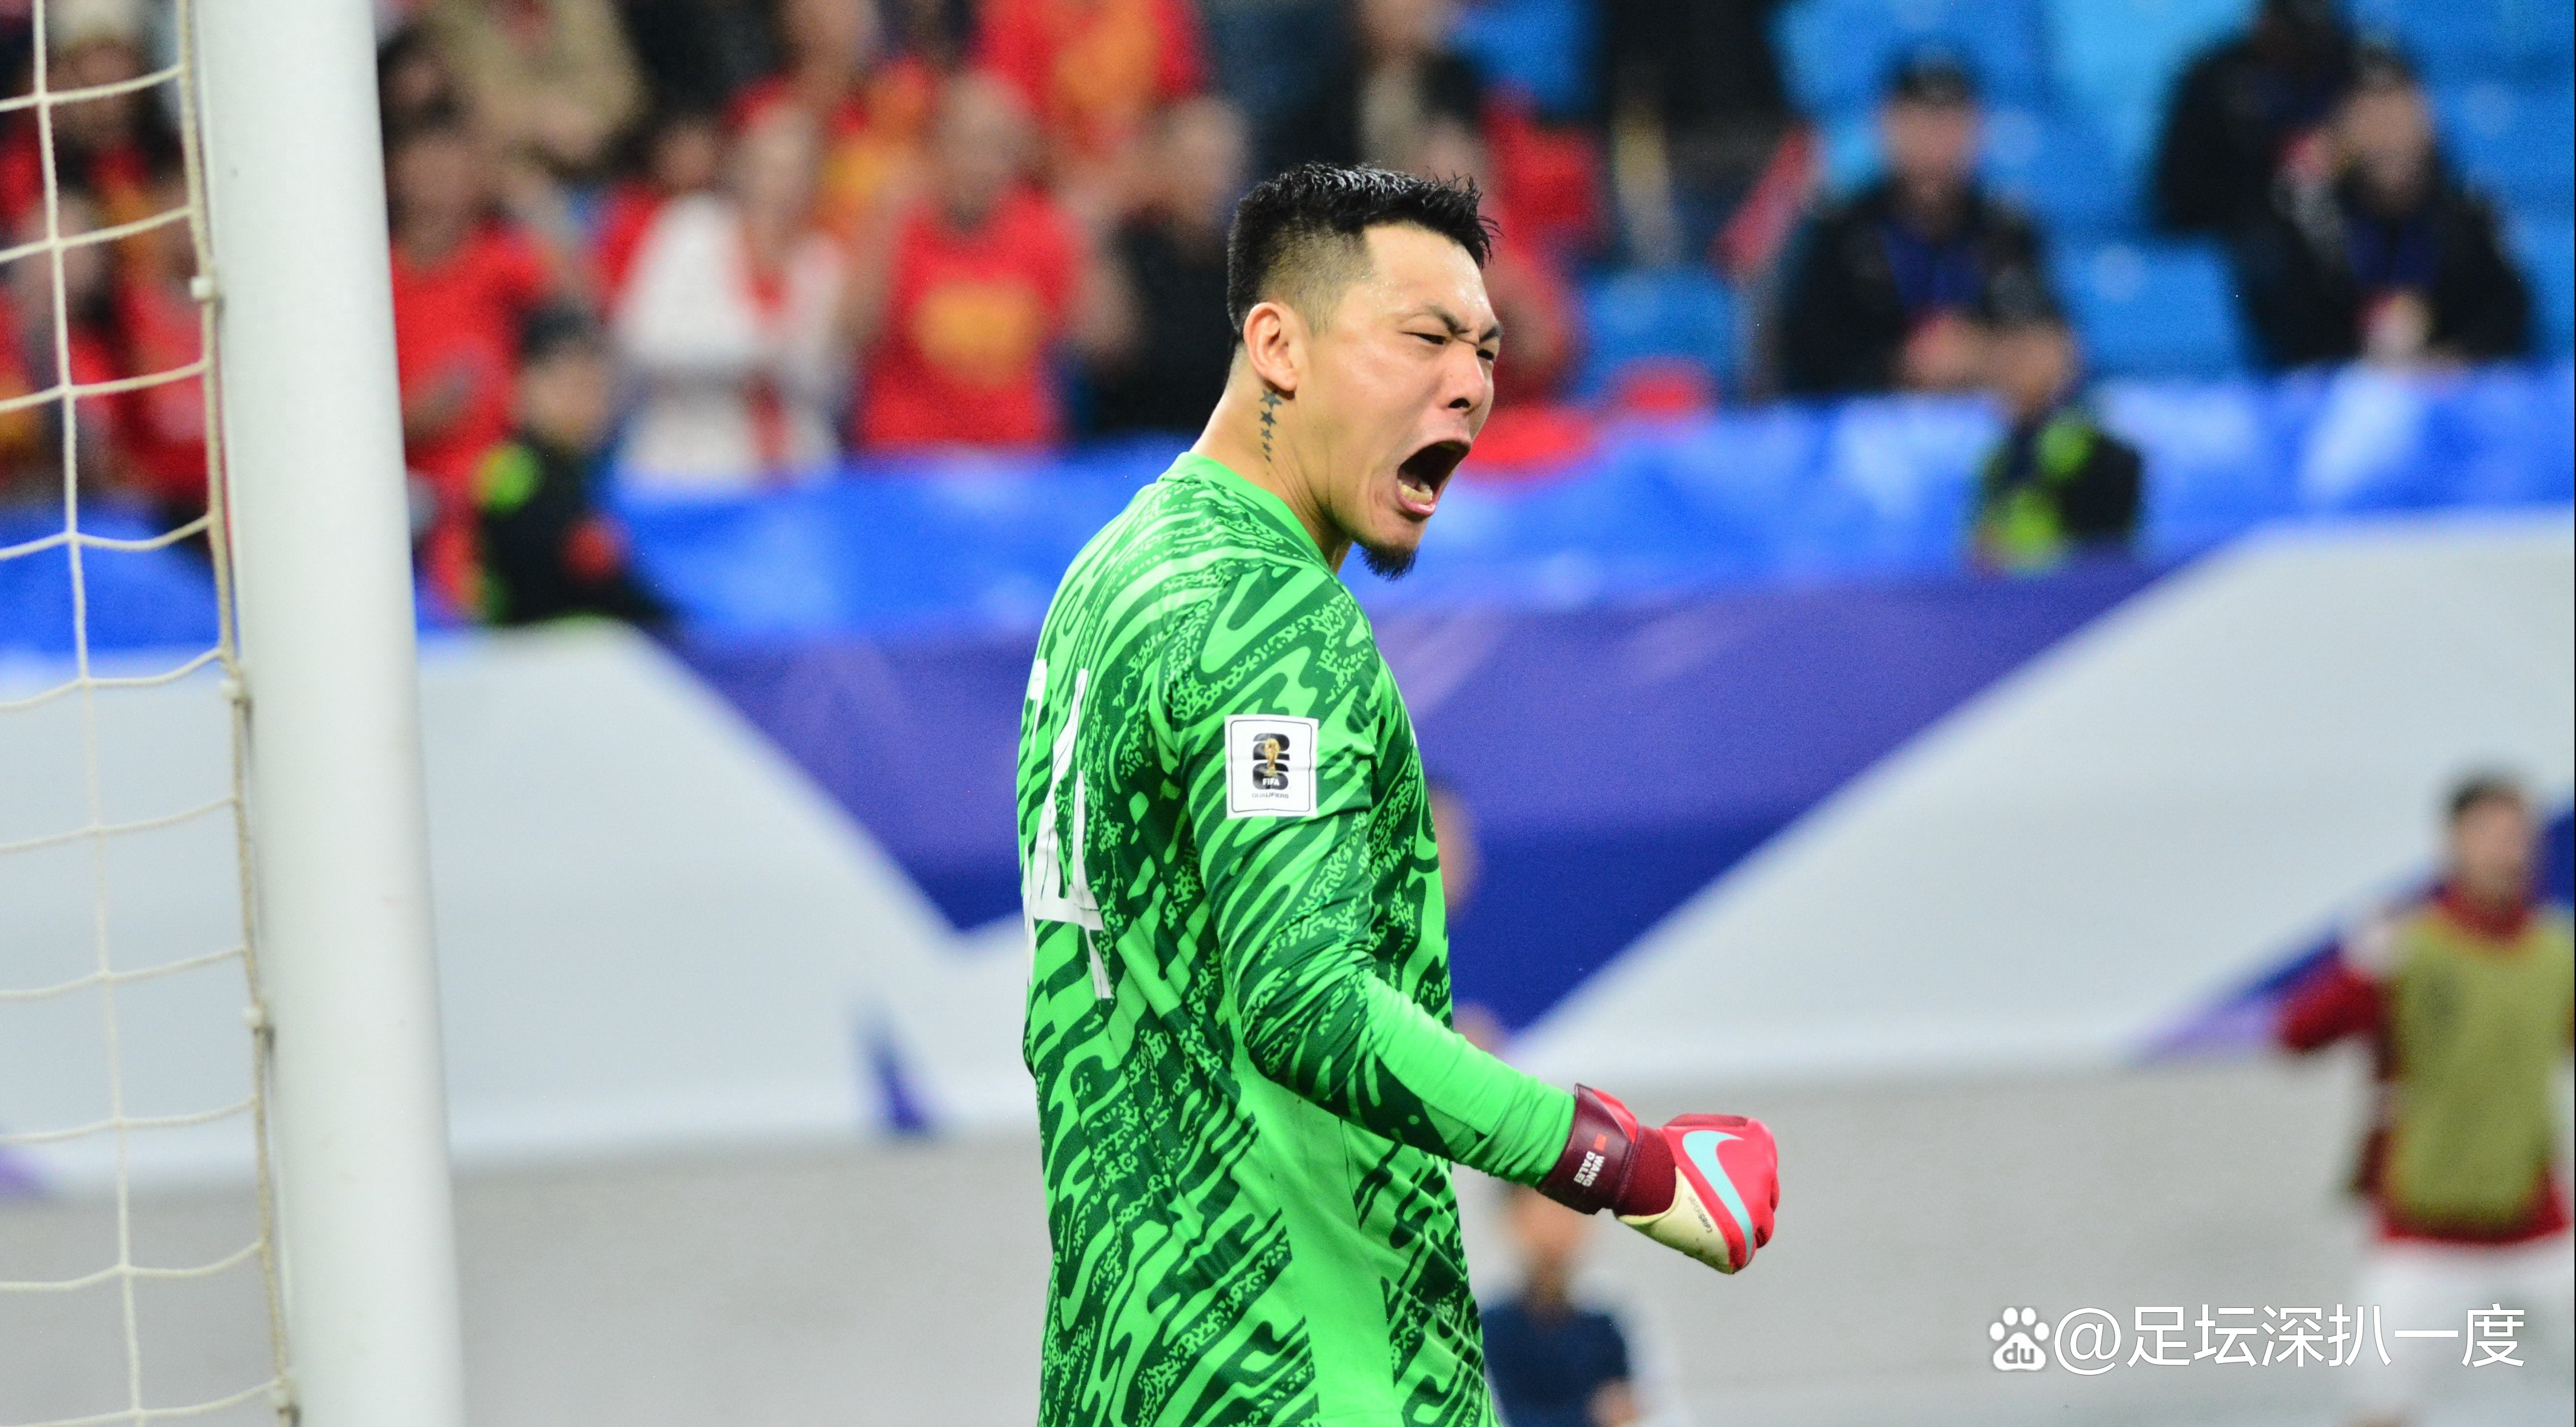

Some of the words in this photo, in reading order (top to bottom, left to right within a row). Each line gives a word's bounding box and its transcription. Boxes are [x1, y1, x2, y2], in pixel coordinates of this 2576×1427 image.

[1262, 777, 1280, 786] FIFA
[1573, 1150, 1596, 1184] DALEI
[1581, 1155, 1605, 1187] WANG
